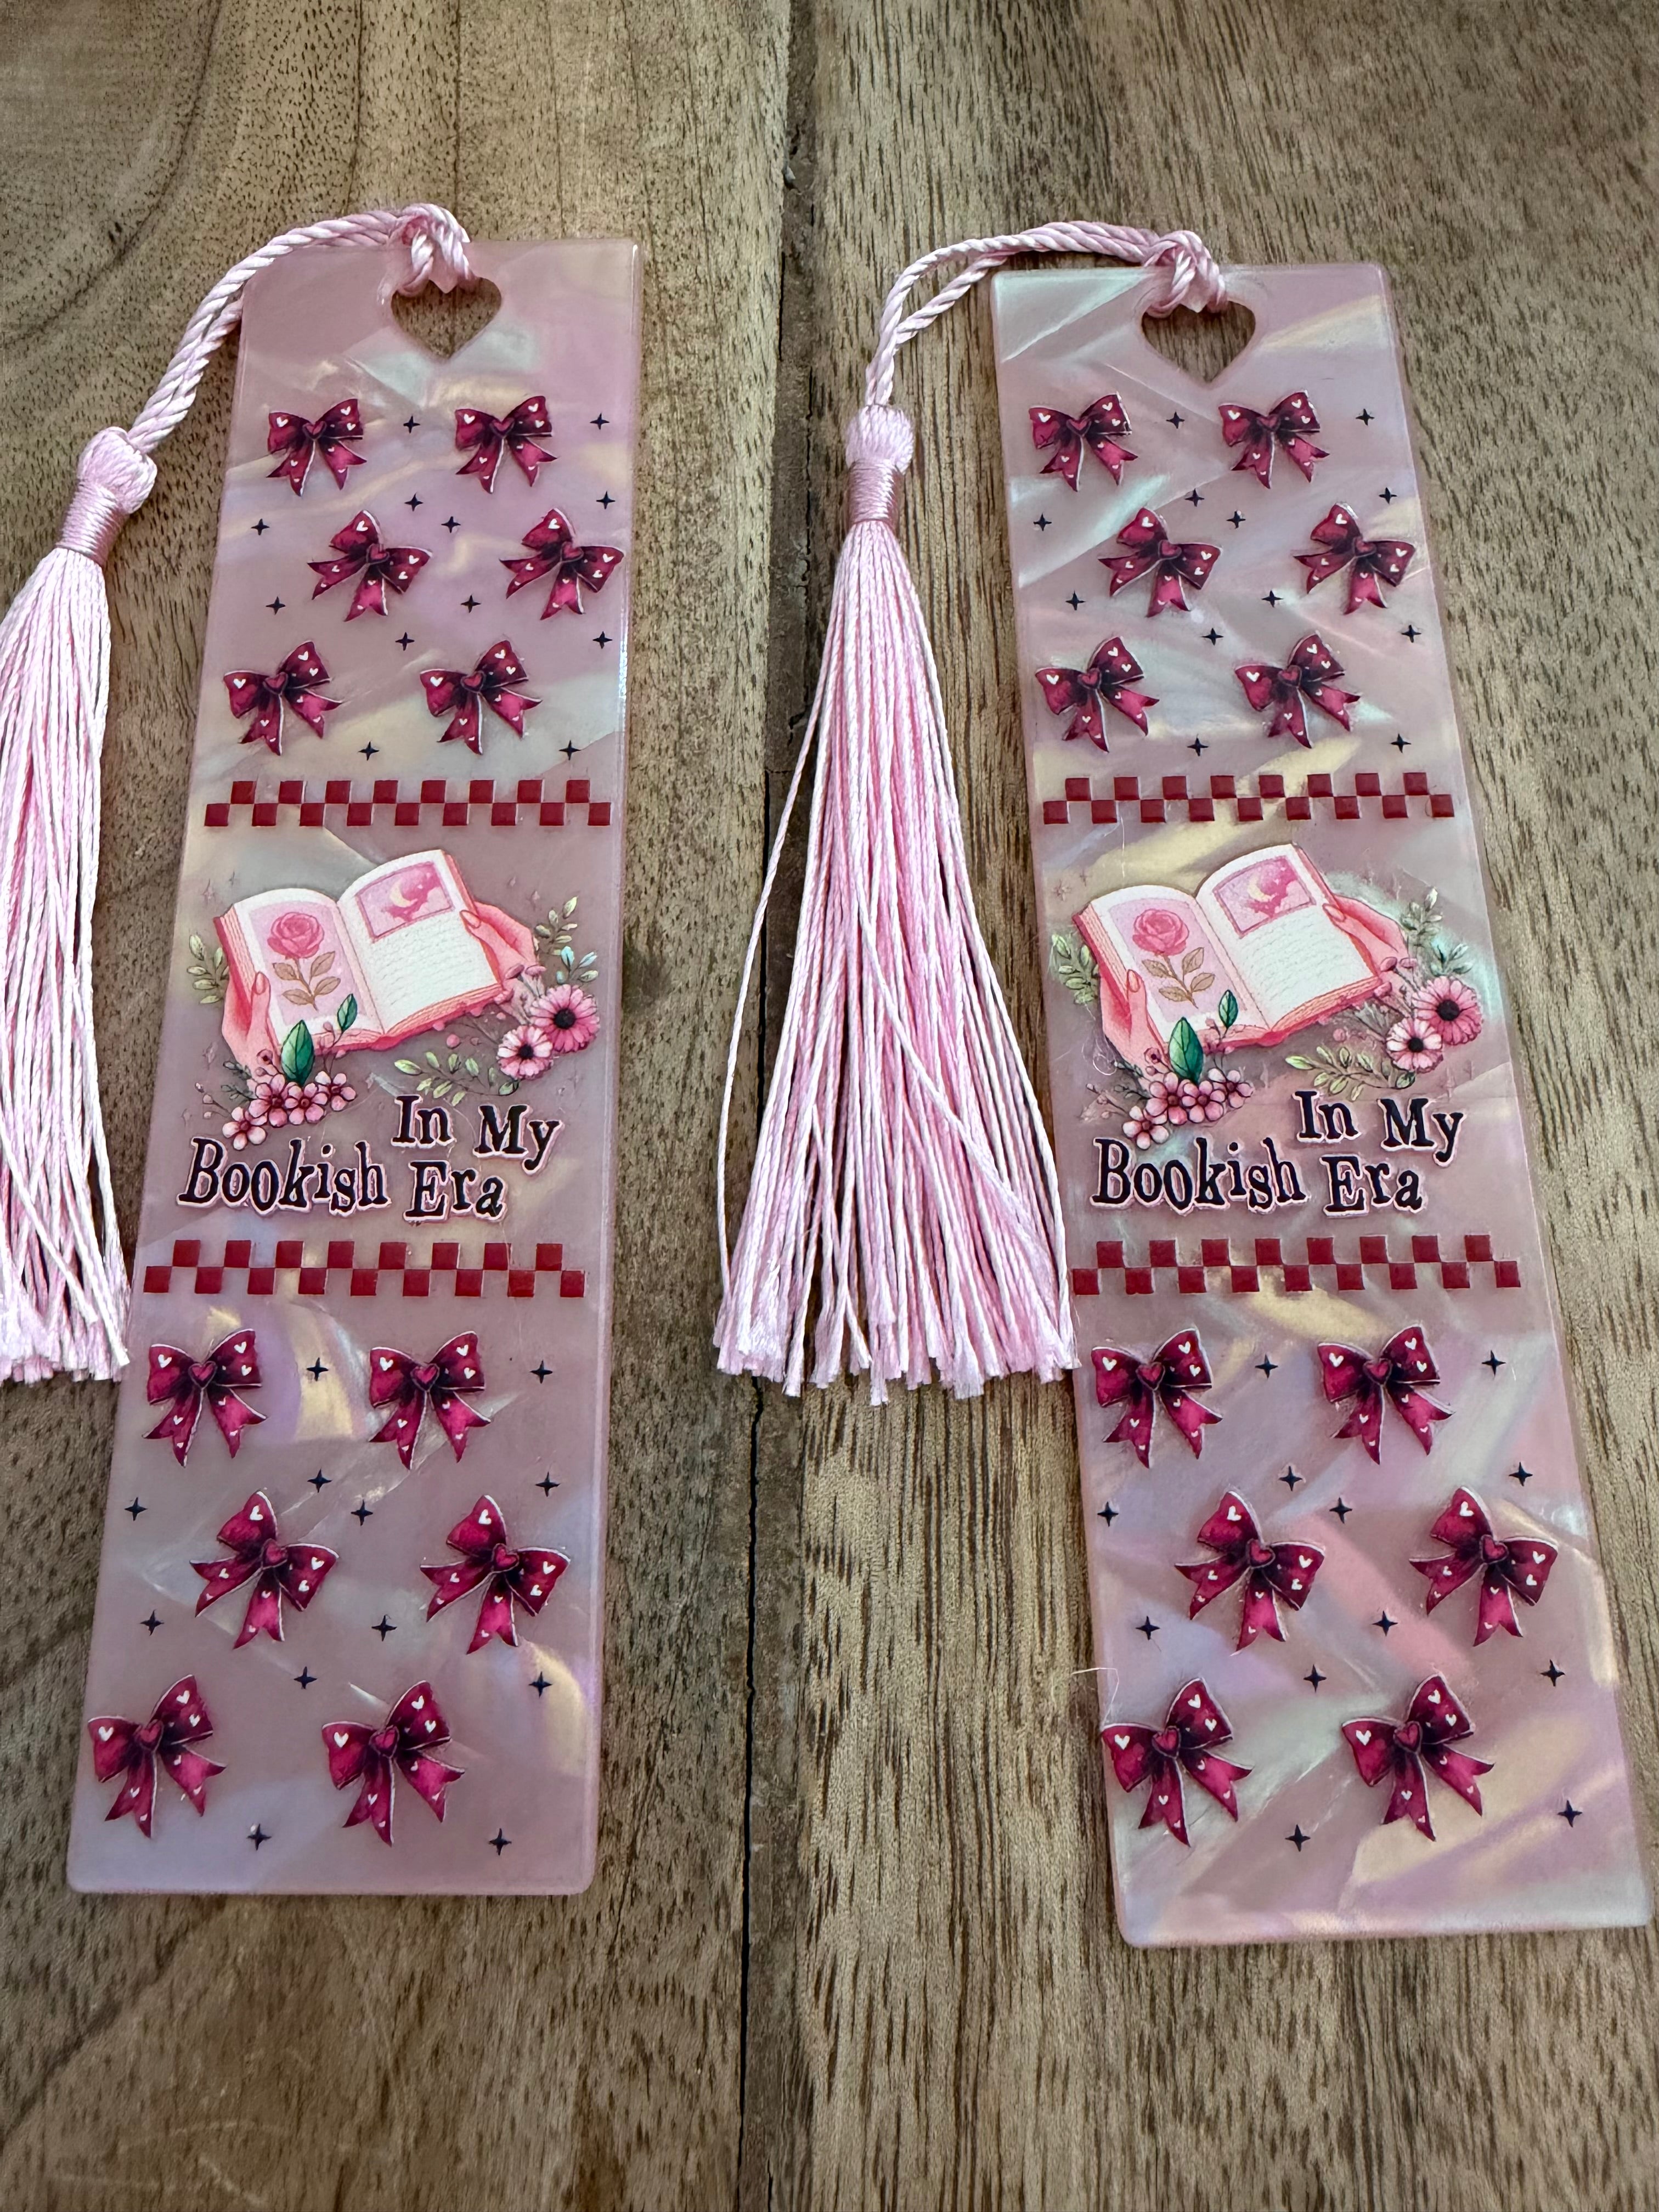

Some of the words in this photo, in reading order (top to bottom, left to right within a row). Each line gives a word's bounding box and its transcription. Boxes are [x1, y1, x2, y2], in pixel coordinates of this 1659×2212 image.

[392, 1094, 454, 1146] In
[474, 1104, 563, 1174] My
[1293, 1090, 1360, 1143] In
[1378, 1098, 1466, 1167] My
[178, 1136, 390, 1216] Bookish
[404, 1160, 507, 1221] Era
[1090, 1137, 1310, 1215] Bookish
[1319, 1154, 1426, 1216] Era
